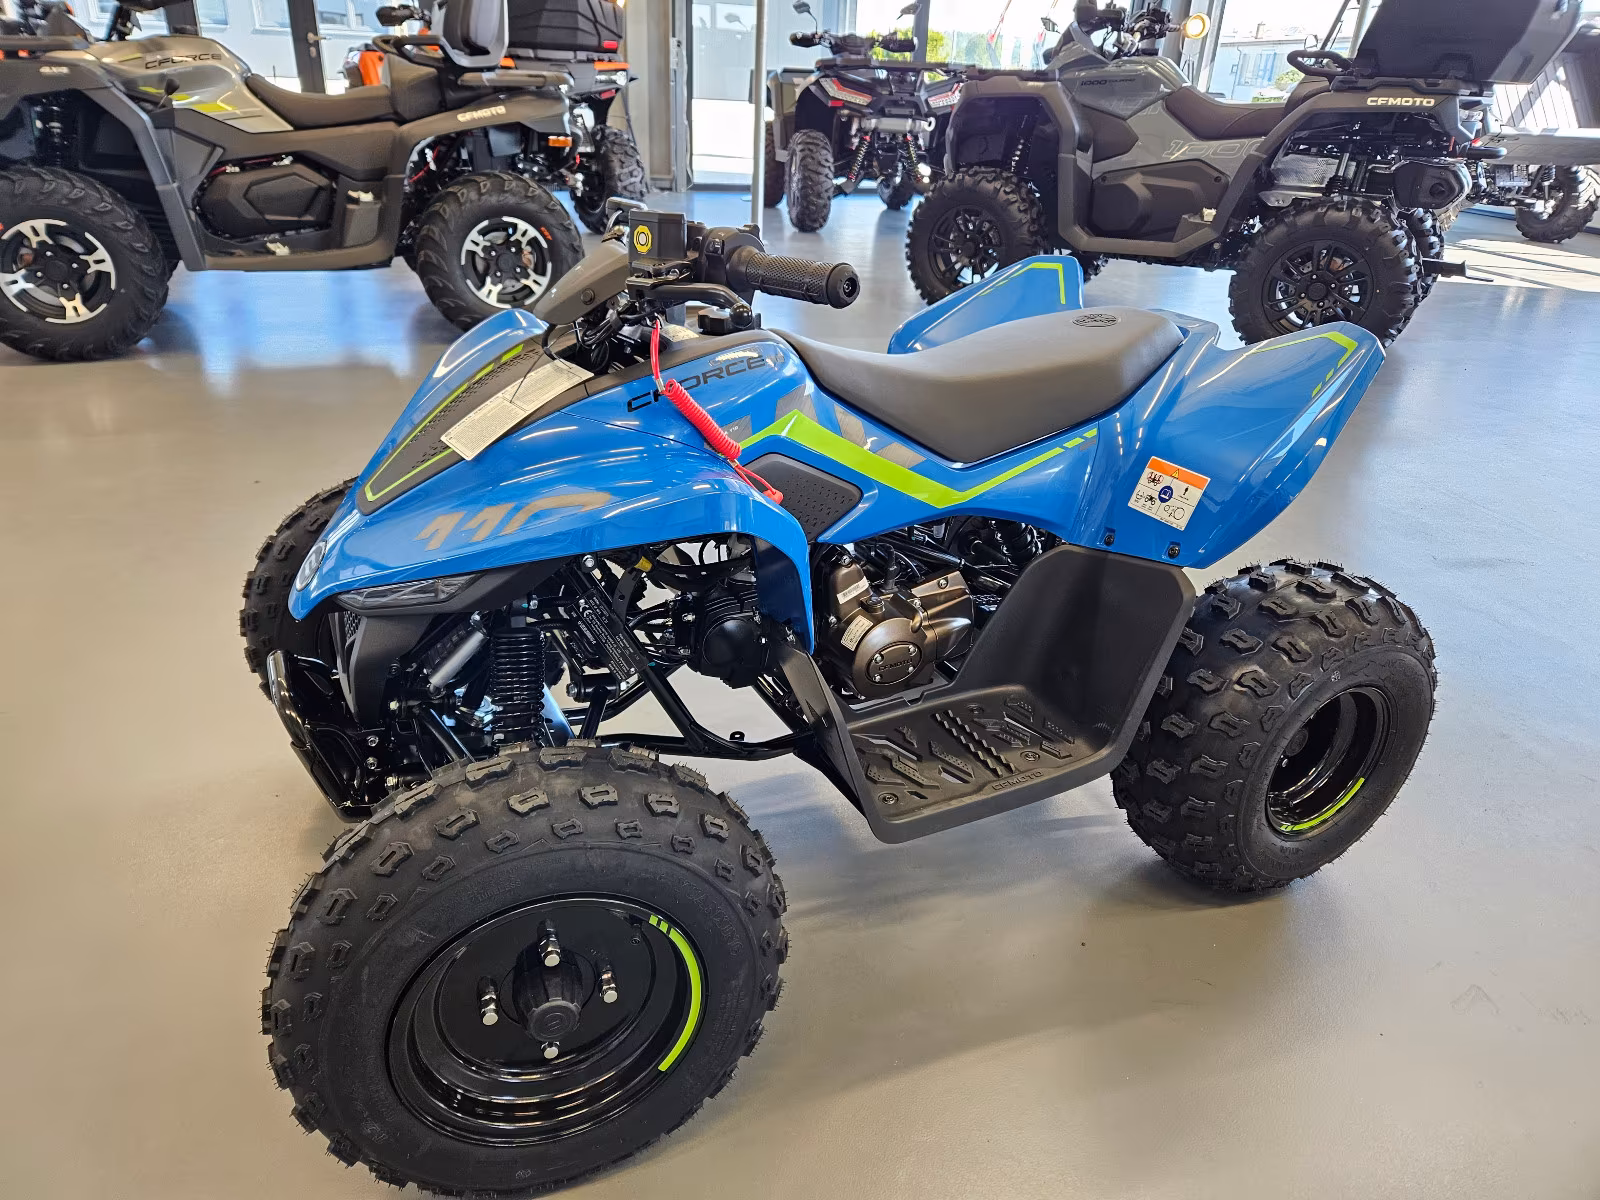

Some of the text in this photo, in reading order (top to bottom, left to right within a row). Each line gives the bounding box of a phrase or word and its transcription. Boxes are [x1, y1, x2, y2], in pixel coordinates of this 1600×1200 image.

[144, 53, 222, 70] CFORCE
[1366, 97, 1435, 107] CFMOTO
[457, 105, 506, 122] CFMOTO
[878, 658, 914, 672] CFMOTO
[991, 771, 1044, 791] CFMOTO
